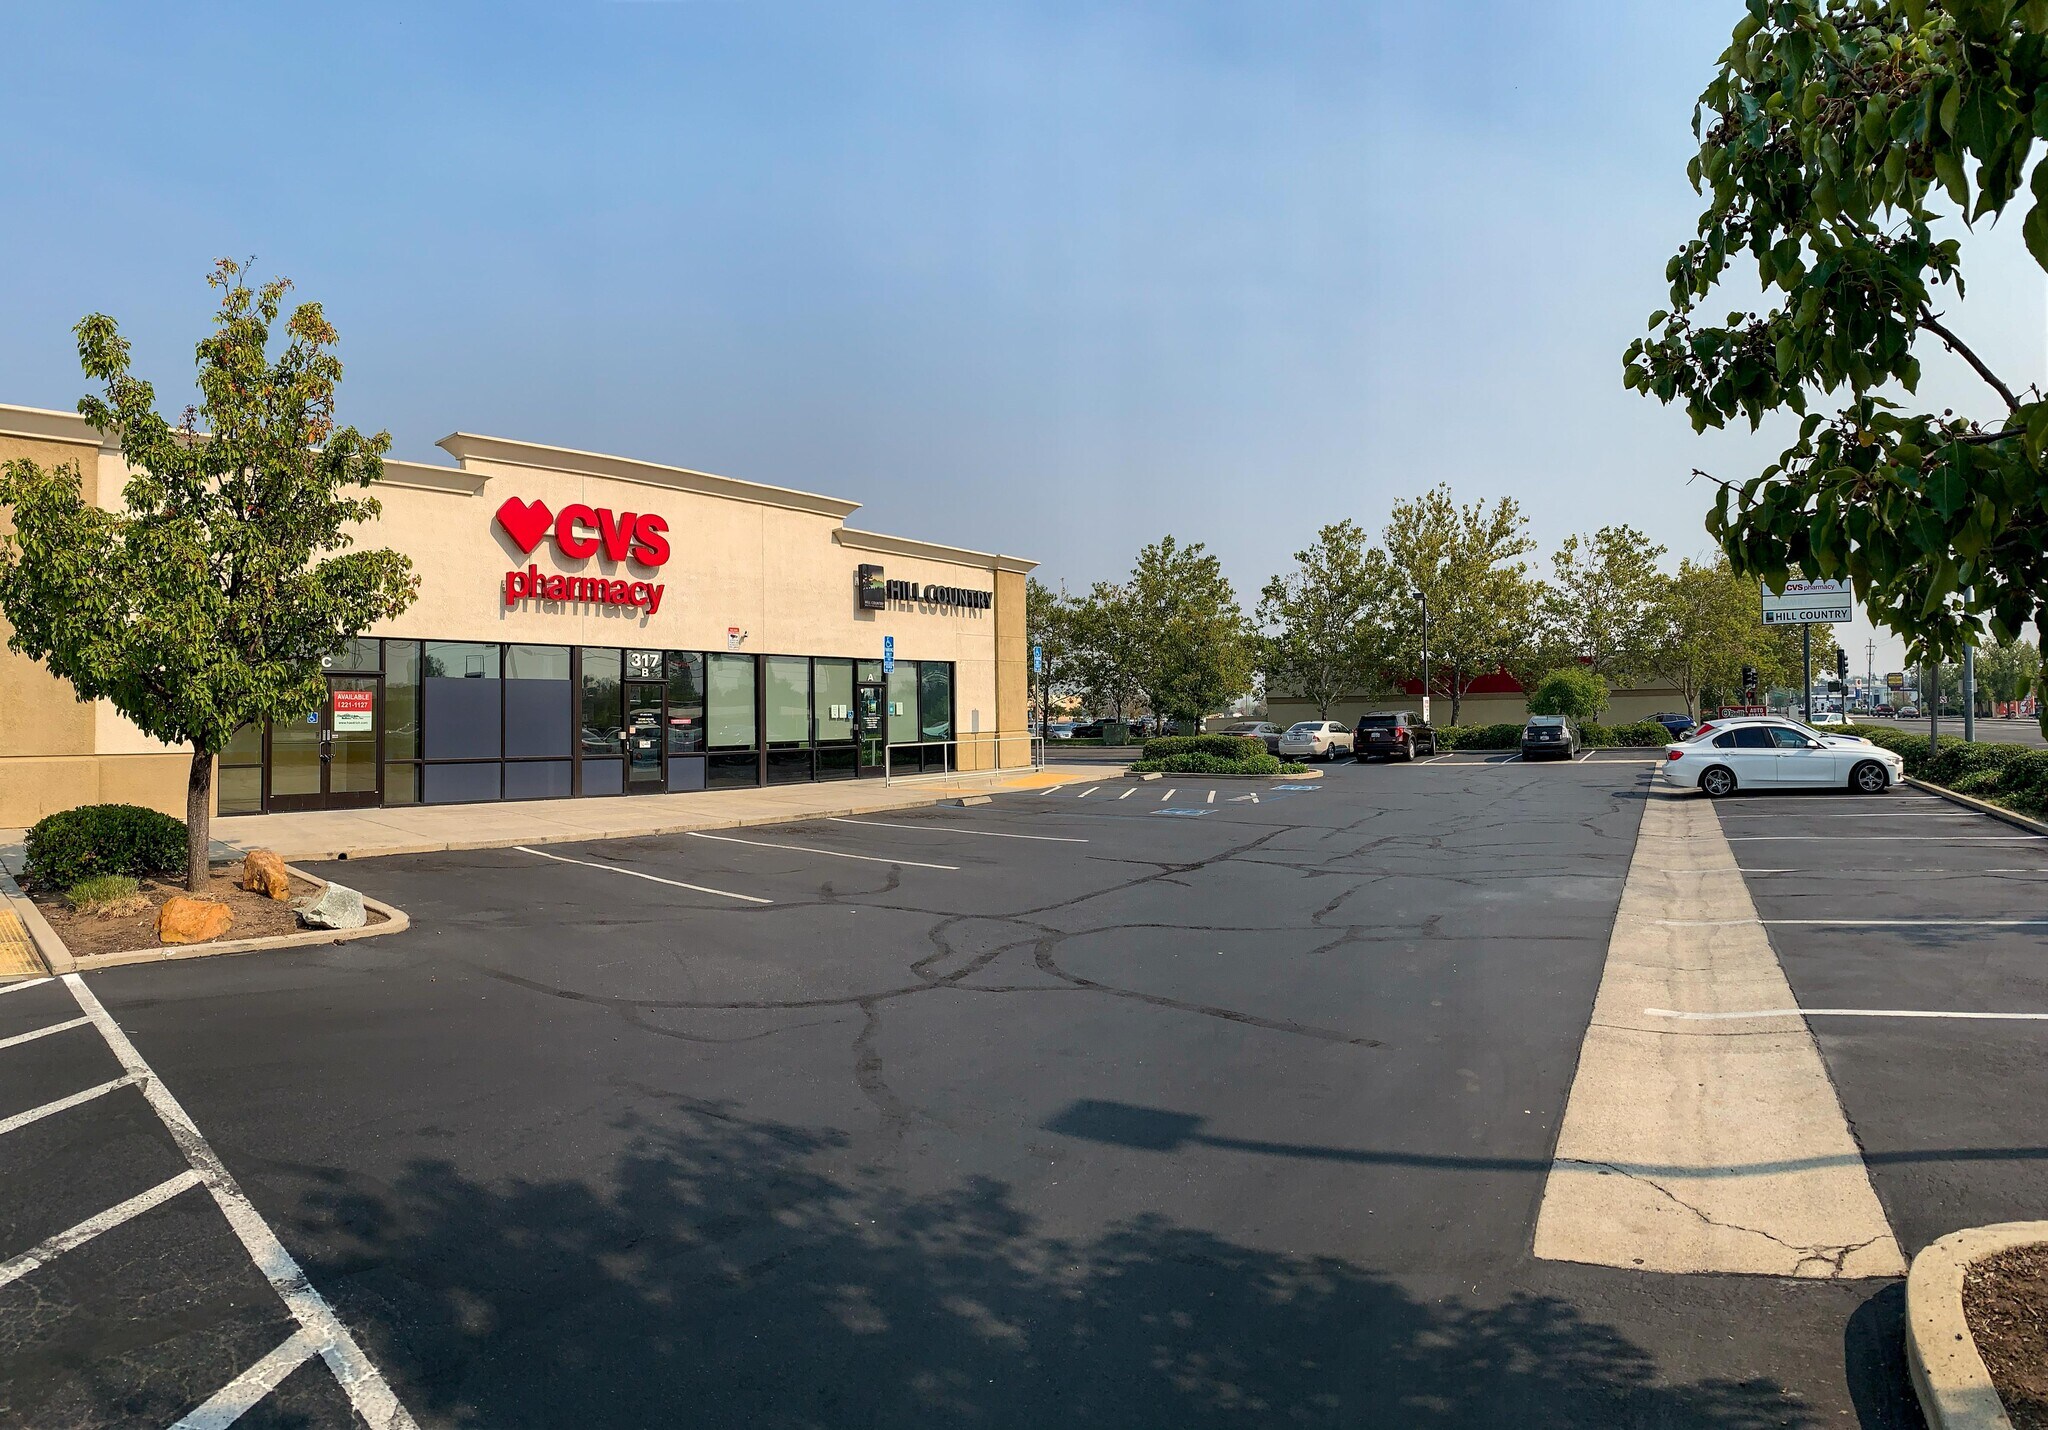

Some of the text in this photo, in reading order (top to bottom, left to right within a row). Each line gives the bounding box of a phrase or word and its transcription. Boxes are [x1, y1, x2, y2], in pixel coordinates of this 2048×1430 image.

[554, 503, 671, 567] CVS
[505, 563, 665, 615] pharmacy
[1804, 583, 1835, 592] pharmacy
[886, 579, 993, 609] HILL COUNTRY
[1776, 609, 1848, 620] HILL COUNTRY
[321, 656, 332, 668] C
[631, 653, 659, 667] 317
[641, 668, 649, 677] B
[867, 673, 874, 682] A
[337, 693, 370, 701] AVAILABLE
